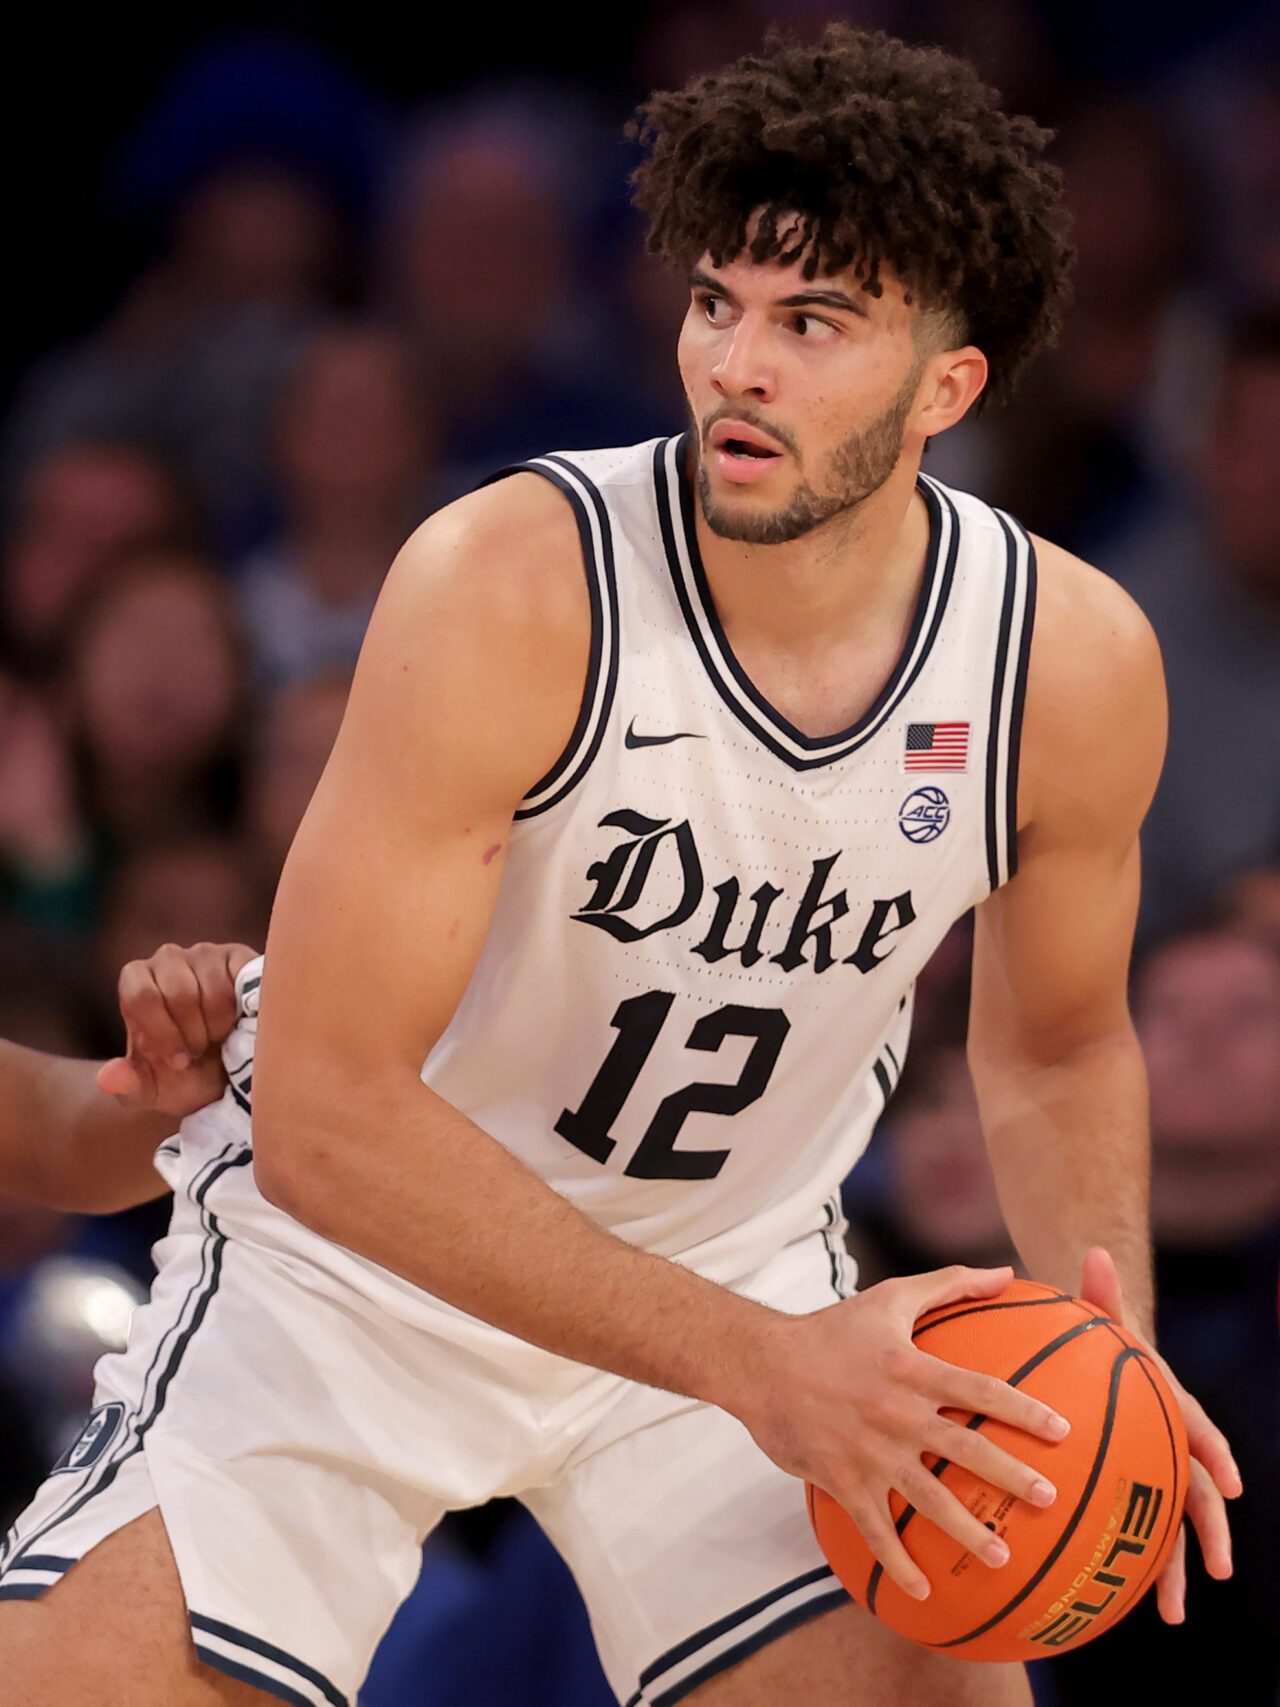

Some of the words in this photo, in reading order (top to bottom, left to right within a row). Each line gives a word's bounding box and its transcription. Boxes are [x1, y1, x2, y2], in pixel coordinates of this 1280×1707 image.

[569, 808, 917, 975] Duke
[906, 804, 949, 819] ACC
[553, 990, 792, 1181] 12
[1019, 1477, 1127, 1638] CAMPIONSHI
[1029, 1480, 1164, 1647] ELITE
